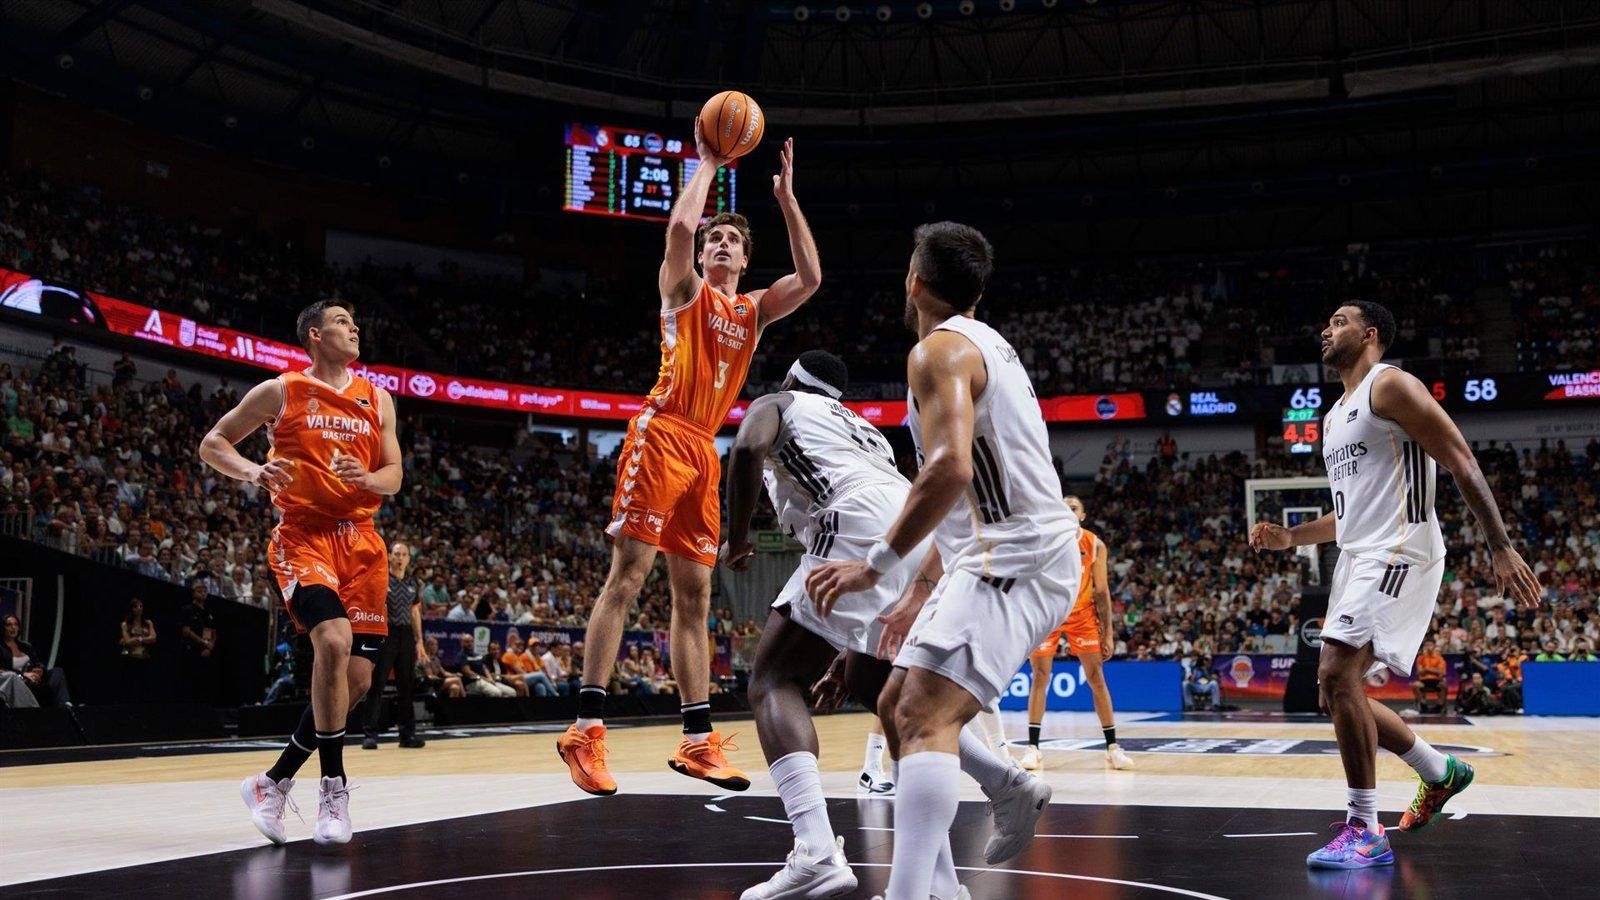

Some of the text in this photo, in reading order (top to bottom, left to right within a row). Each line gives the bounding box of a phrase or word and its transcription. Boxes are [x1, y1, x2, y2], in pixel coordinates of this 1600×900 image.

[624, 134, 640, 148] 65
[666, 140, 682, 154] 58
[640, 166, 669, 183] 2:08
[717, 334, 744, 351] BASKET
[714, 360, 729, 389] 3
[1190, 392, 1218, 404] REAL
[1290, 388, 1322, 409] 65
[1432, 382, 1446, 401] 5
[1464, 378, 1498, 401] 58
[1190, 402, 1237, 415] MADRID
[306, 415, 371, 436] VALENCIA
[1283, 423, 1319, 444] 4.5
[322, 430, 356, 442] BASKET
[1325, 441, 1368, 472] mirates
[1334, 460, 1358, 481] BETTER
[353, 611, 385, 623] Midea
